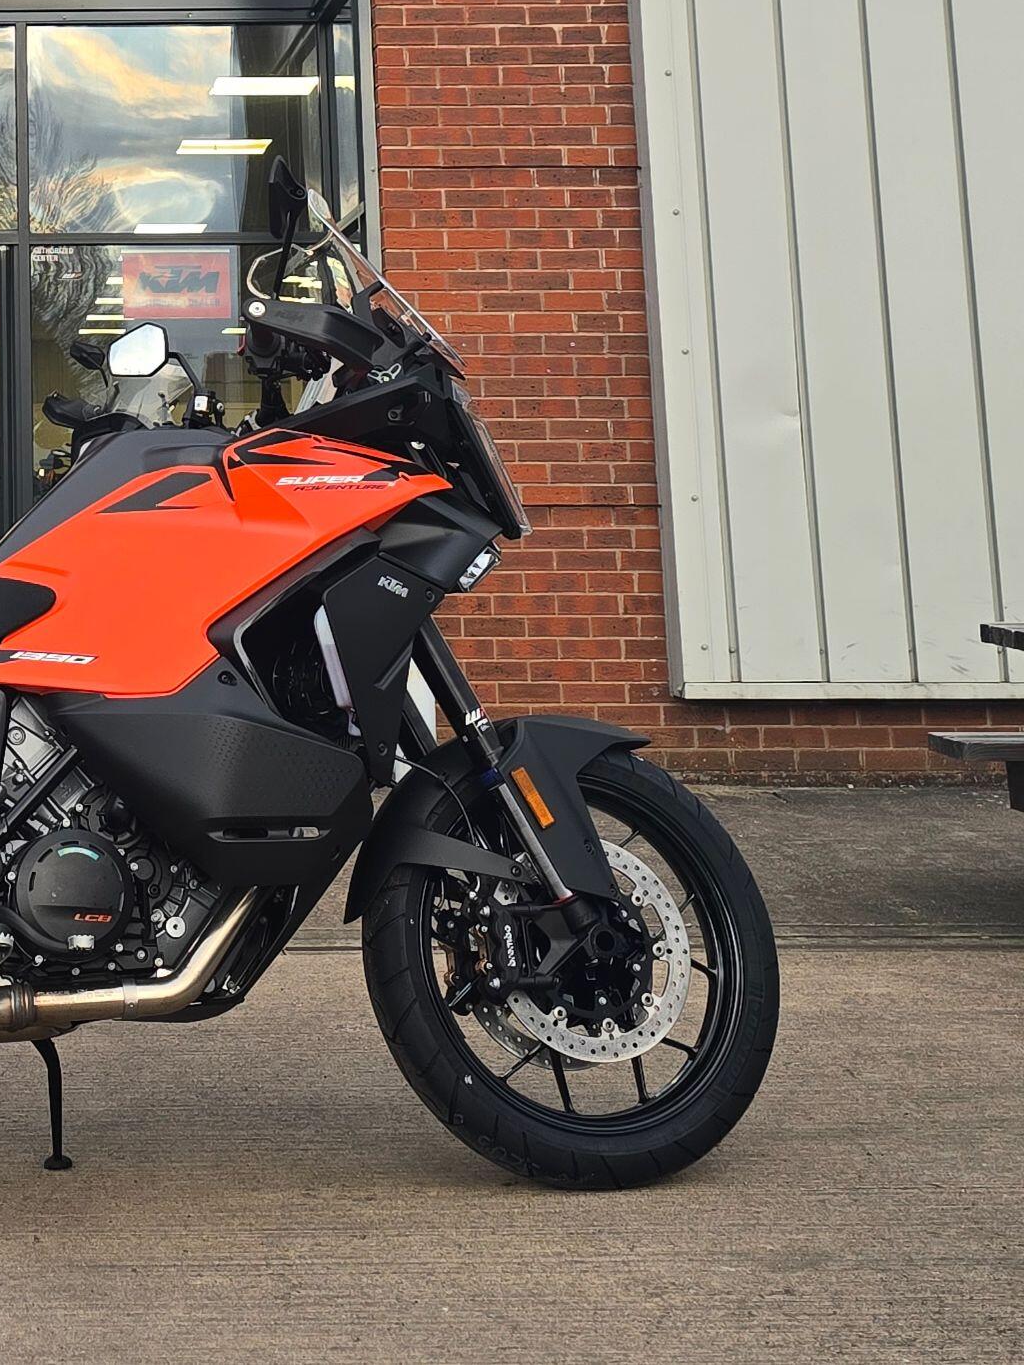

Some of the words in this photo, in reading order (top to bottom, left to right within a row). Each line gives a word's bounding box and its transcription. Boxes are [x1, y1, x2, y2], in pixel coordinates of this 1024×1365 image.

[138, 264, 220, 294] KTM
[276, 474, 365, 486] SUPER
[377, 575, 409, 598] KTM
[503, 924, 517, 967] brembo
